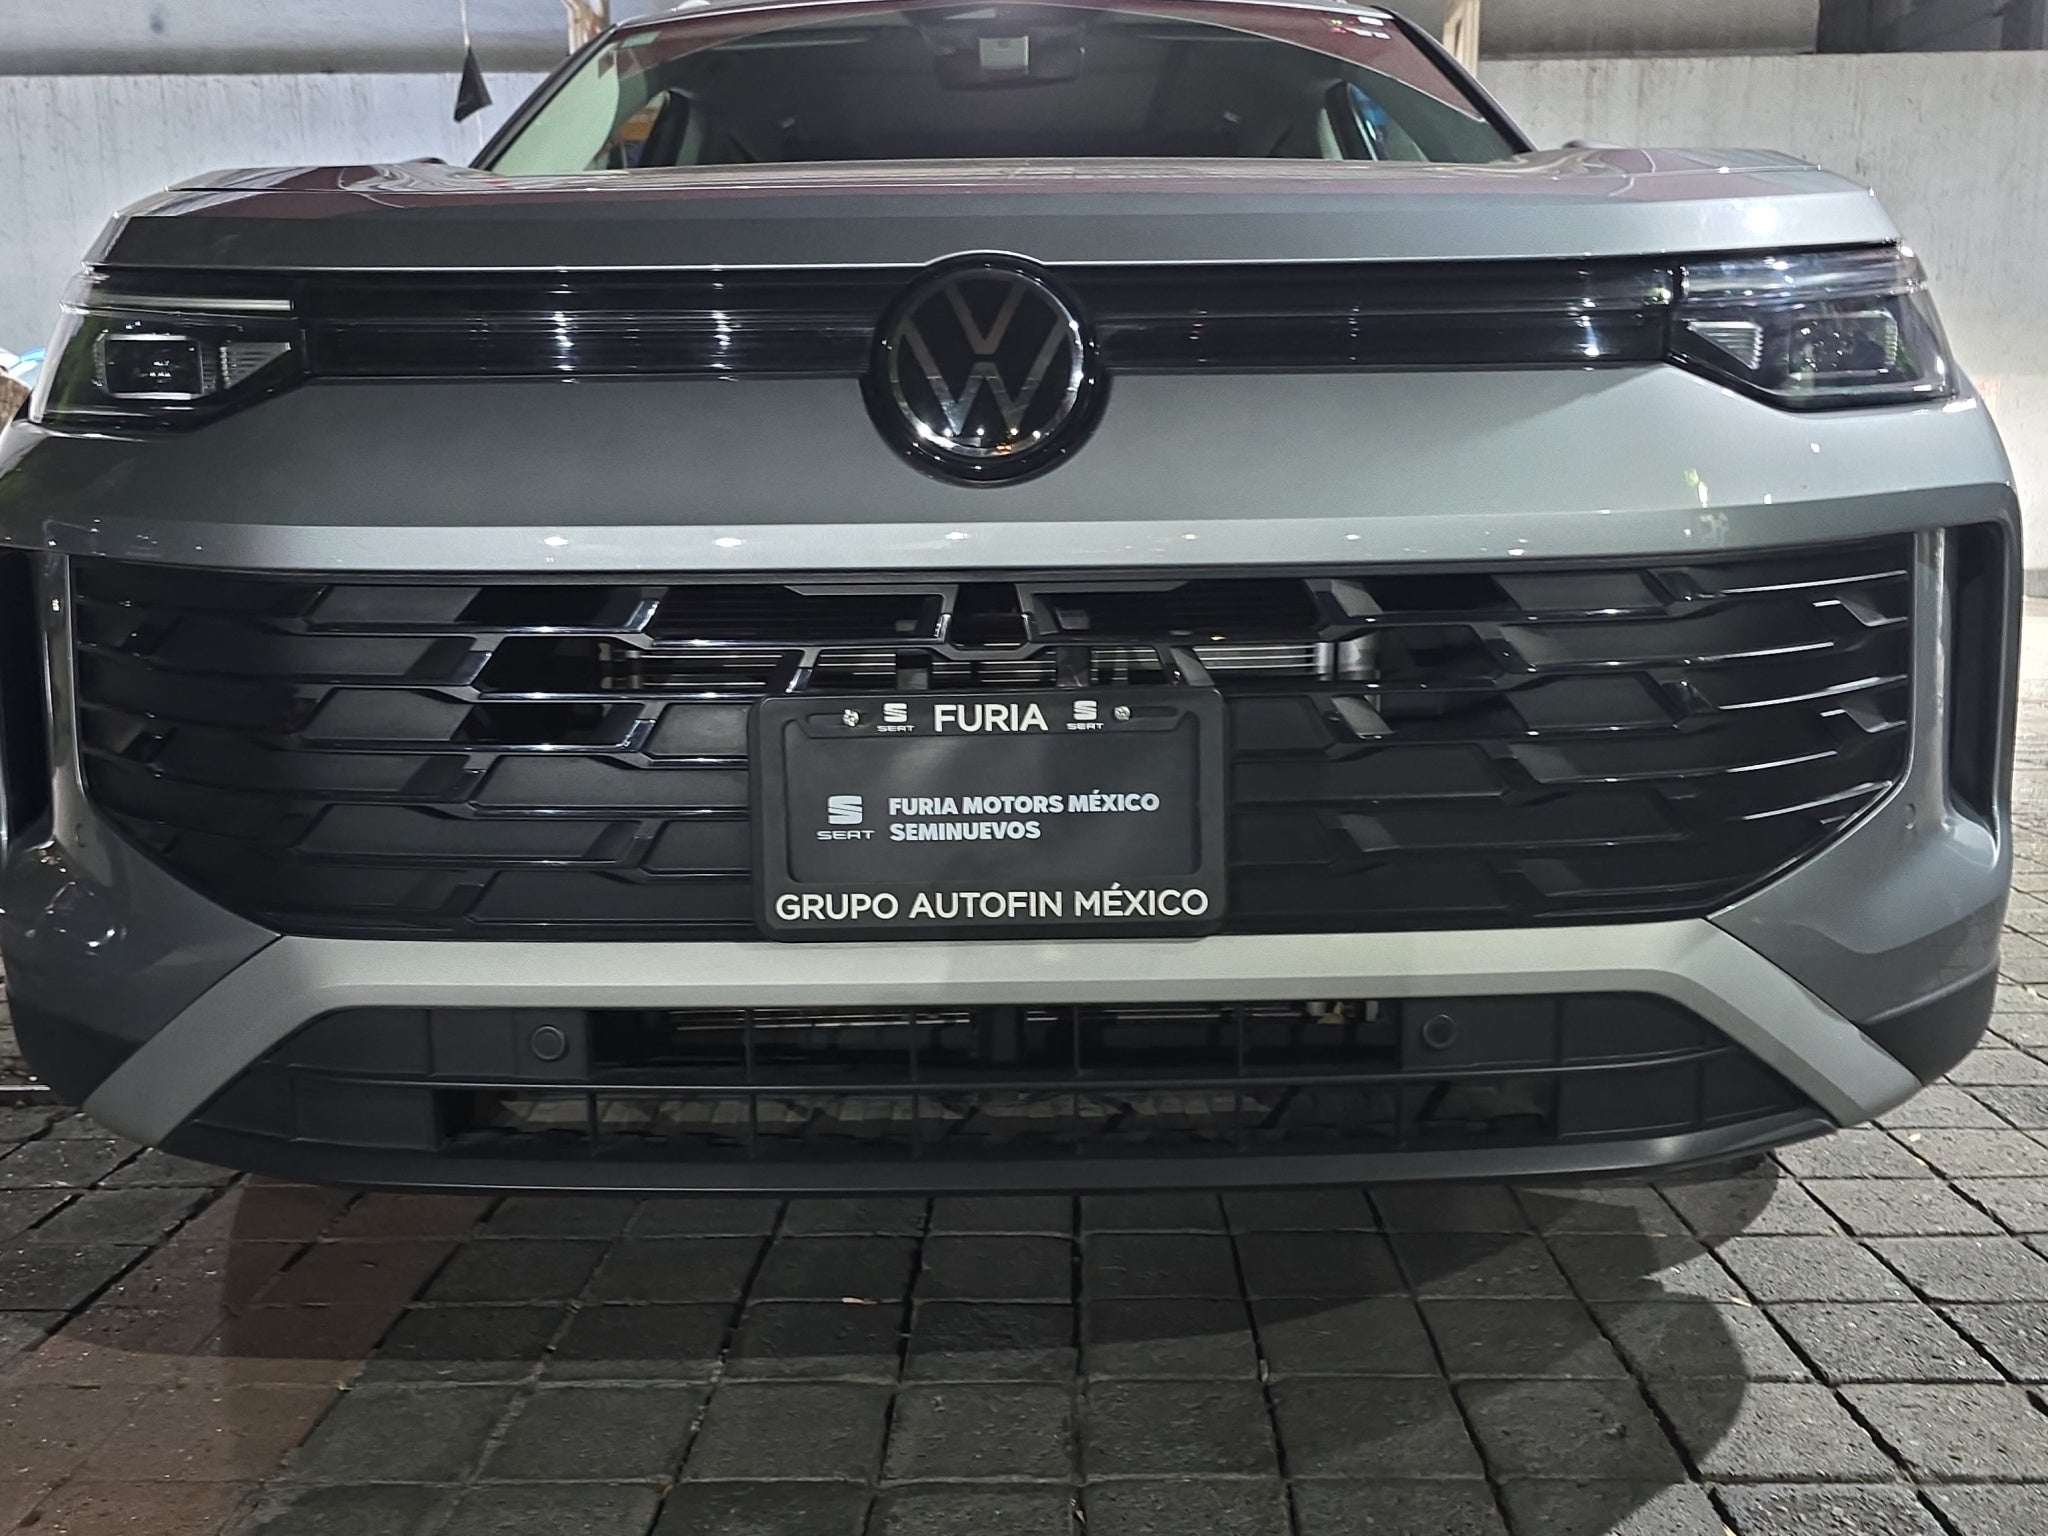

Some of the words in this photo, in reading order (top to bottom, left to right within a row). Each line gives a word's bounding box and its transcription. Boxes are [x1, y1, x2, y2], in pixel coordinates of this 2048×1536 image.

[876, 724, 915, 733] SEAT
[933, 702, 1049, 733] FURIA
[1066, 721, 1104, 731] SEAT
[888, 796, 960, 817] FURIA
[962, 793, 1064, 815] MOTORS
[1067, 789, 1160, 813] MÉXICO
[816, 829, 876, 841] SEAT
[889, 820, 1041, 843] SEMINUEVOS
[775, 892, 899, 921] GRUPO
[908, 890, 1063, 919] AUTOFIN
[1074, 882, 1209, 918] MÉXICO
